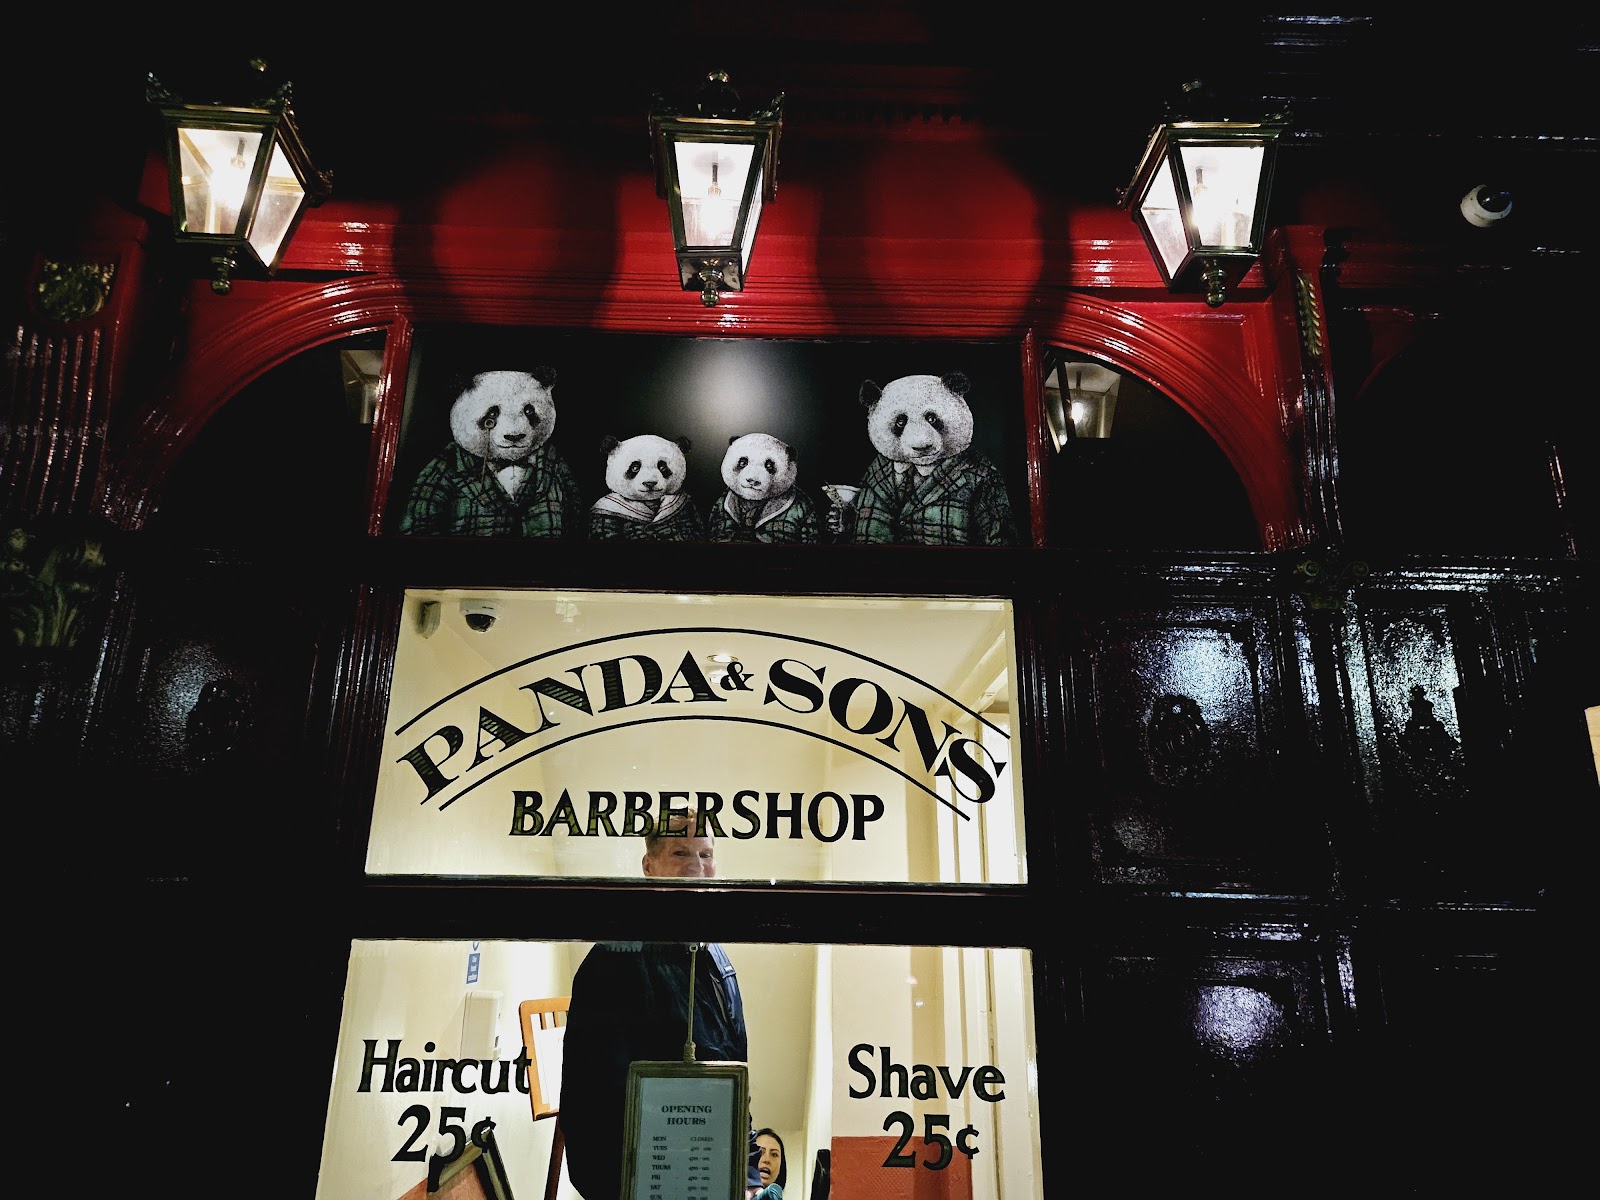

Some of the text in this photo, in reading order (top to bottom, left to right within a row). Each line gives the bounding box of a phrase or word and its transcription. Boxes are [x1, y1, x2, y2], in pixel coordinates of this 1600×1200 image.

[396, 650, 1006, 805] PANDA & SONS
[508, 787, 885, 843] BARBERSHOP
[356, 1039, 532, 1095] Haircut
[848, 1043, 1006, 1103] Shave
[661, 1104, 712, 1114] OPENING
[666, 1117, 707, 1126] HOURS
[882, 1110, 980, 1171] 25¢
